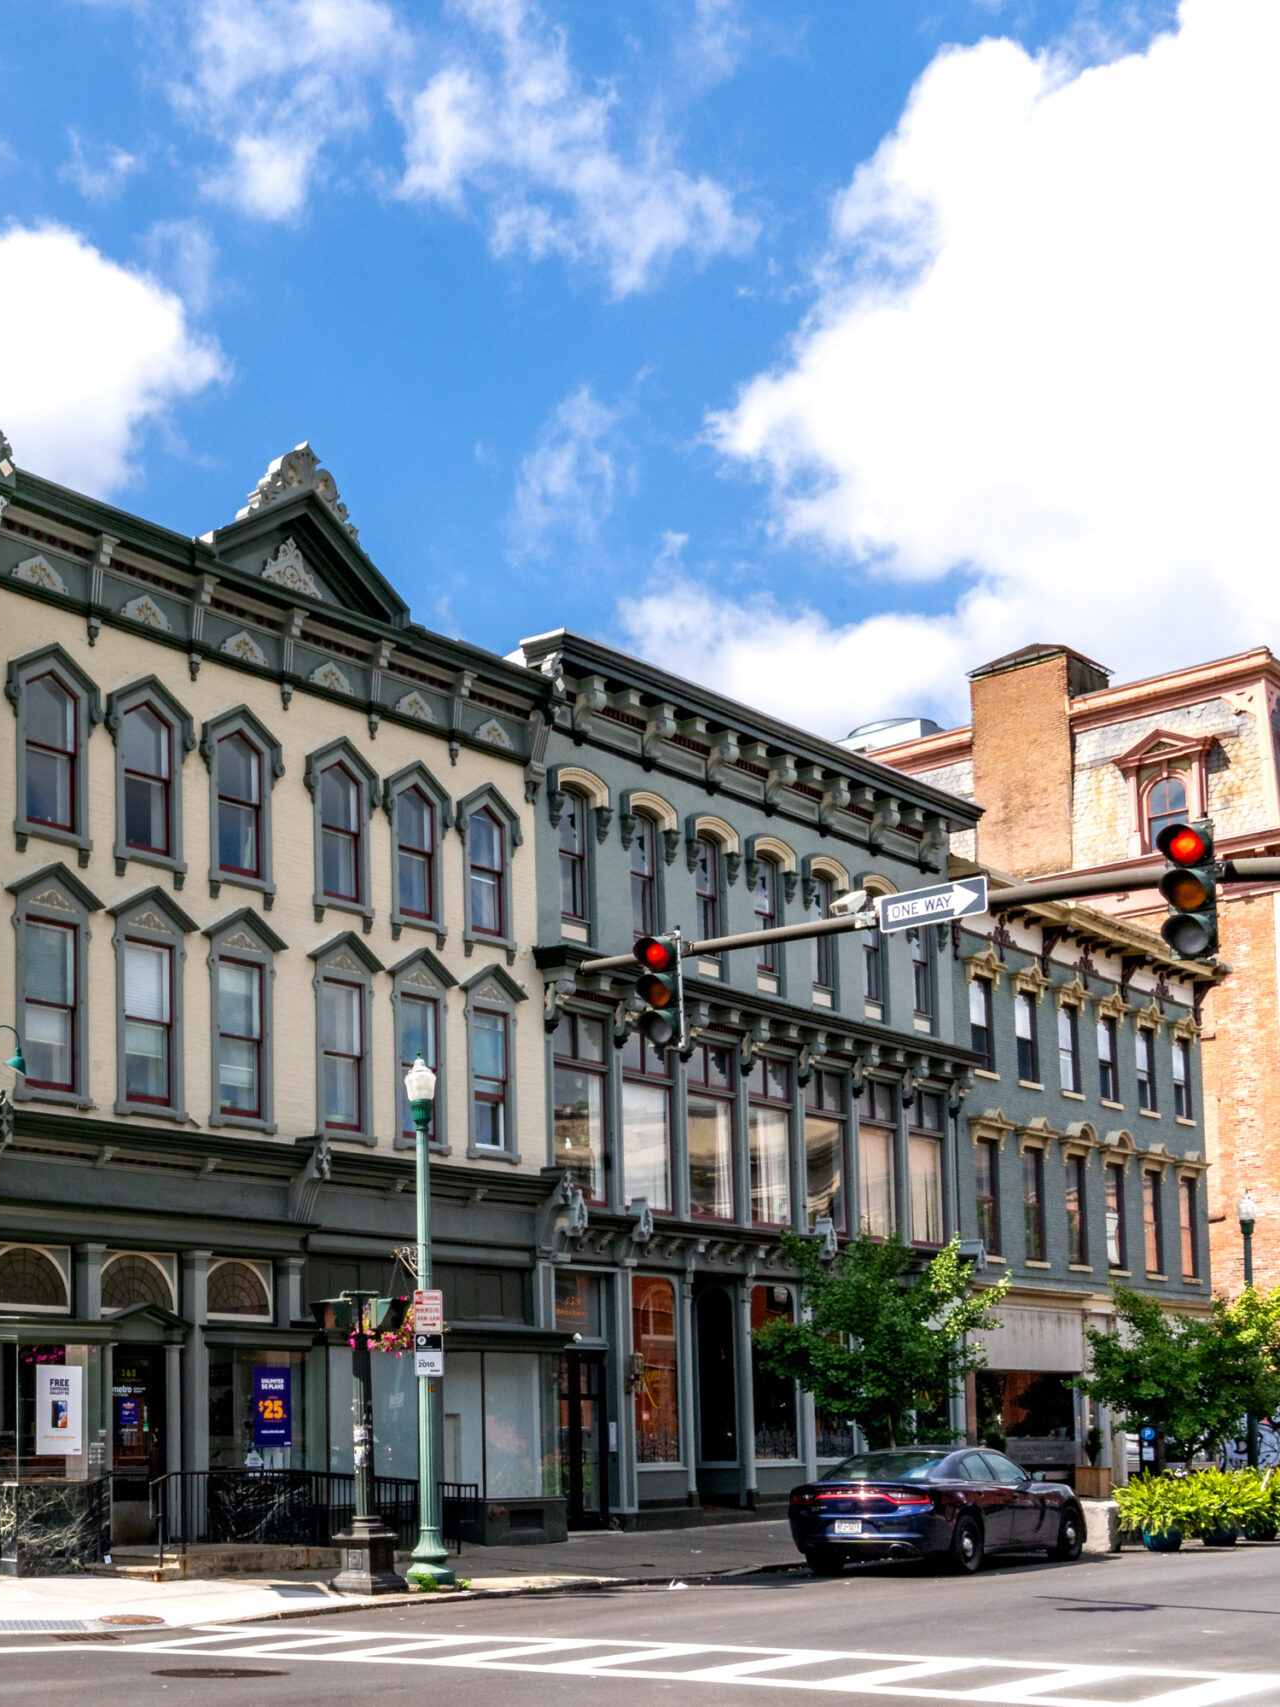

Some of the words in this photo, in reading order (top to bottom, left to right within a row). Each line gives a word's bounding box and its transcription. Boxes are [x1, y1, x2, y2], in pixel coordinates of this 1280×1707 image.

[892, 902, 918, 918] ONE
[925, 895, 951, 911] WAY
[258, 1400, 283, 1419] $25
